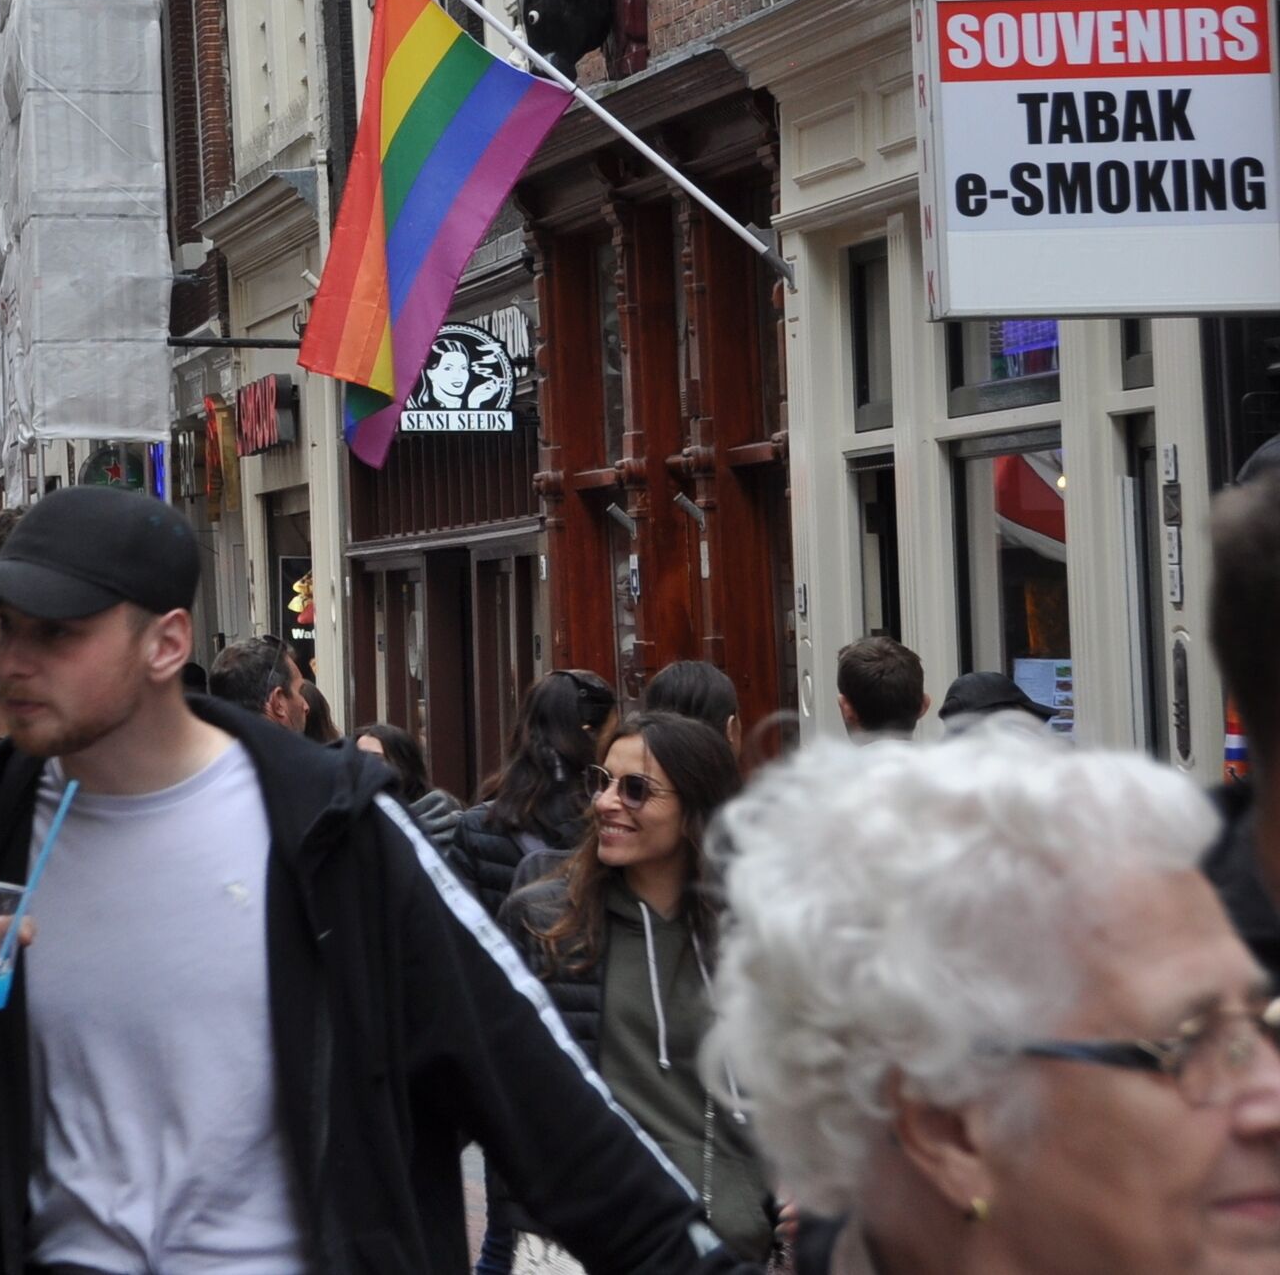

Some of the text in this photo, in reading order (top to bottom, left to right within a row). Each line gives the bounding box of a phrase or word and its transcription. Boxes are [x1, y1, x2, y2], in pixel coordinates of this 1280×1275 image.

[946, 5, 1260, 70] SOUVENIRS
[1017, 88, 1196, 145] TABAK
[954, 156, 1267, 218] e-SMOKING
[406, 412, 507, 430] SENSI SEEDS
